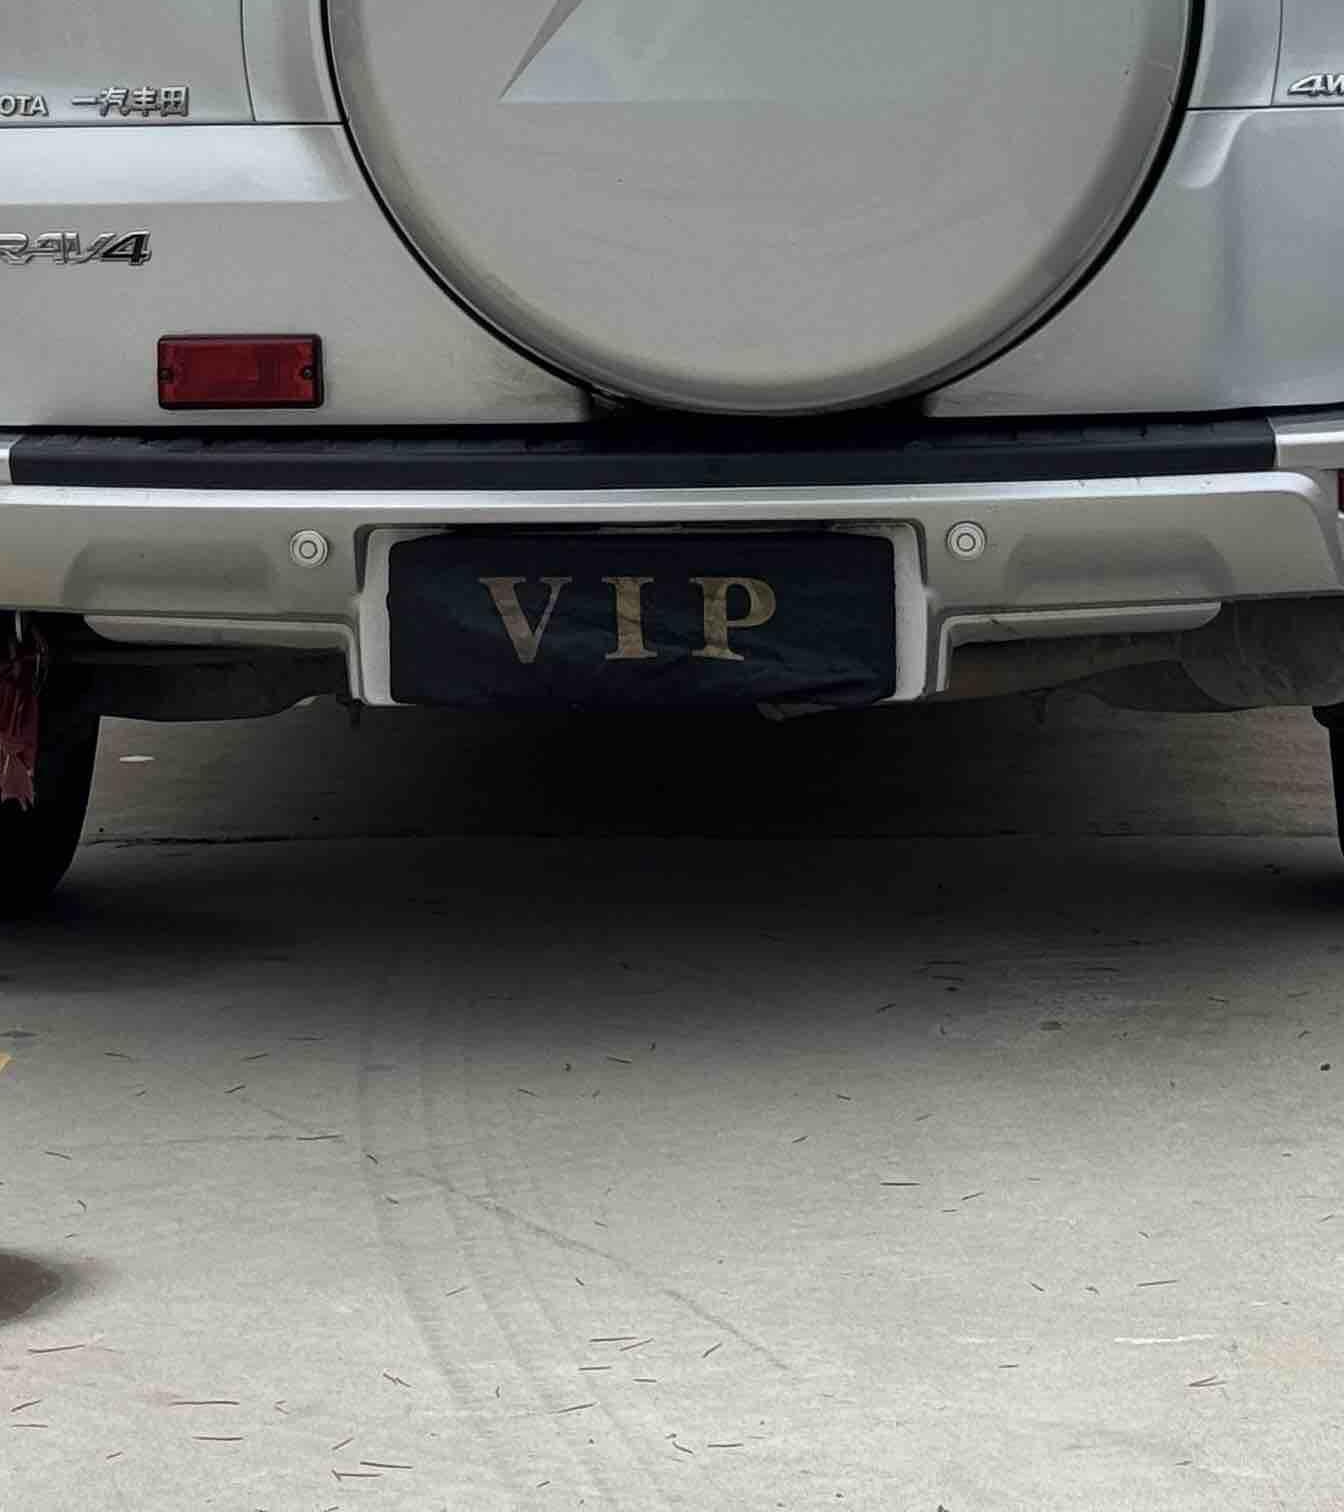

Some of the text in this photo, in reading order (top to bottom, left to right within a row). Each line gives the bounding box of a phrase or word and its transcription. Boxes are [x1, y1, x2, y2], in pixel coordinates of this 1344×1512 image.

[71, 86, 189, 117] 一汽丰田
[477, 576, 777, 664] VIP
